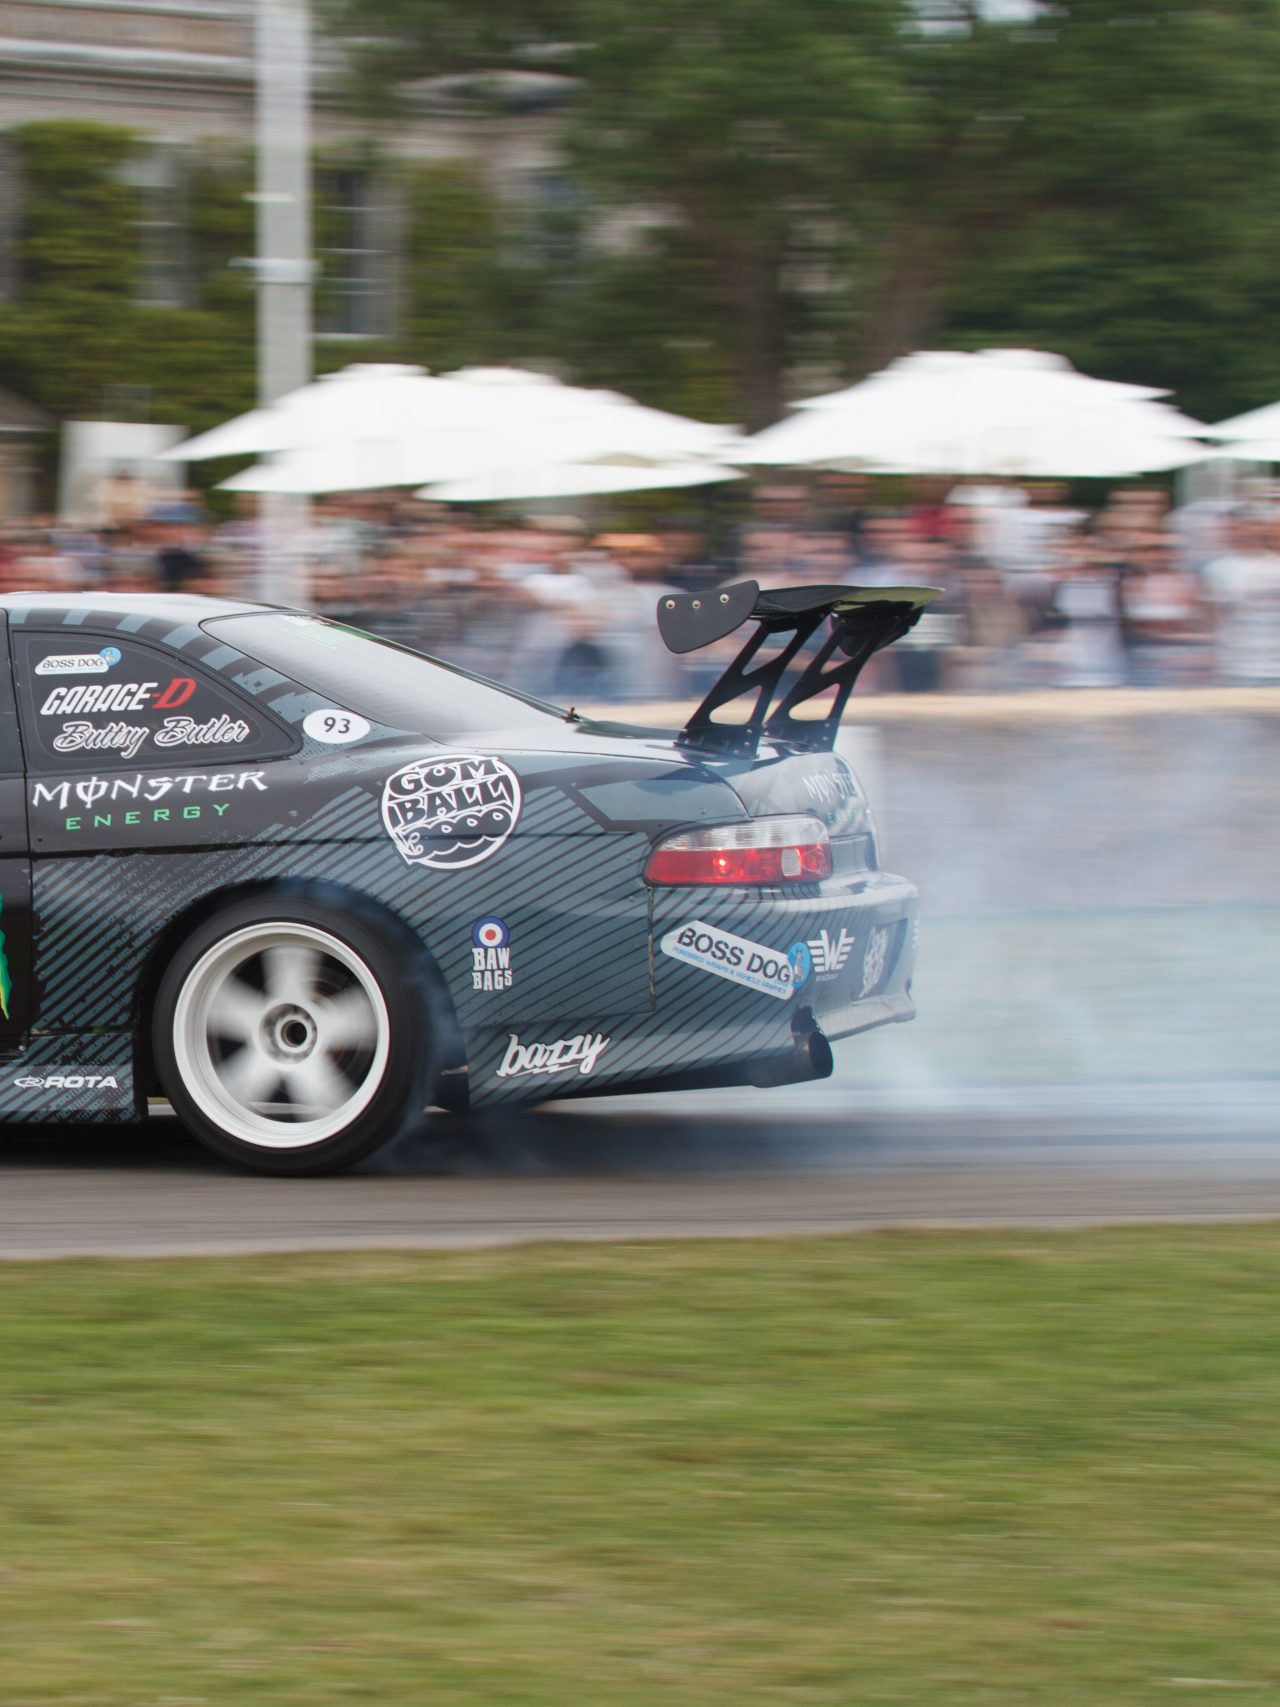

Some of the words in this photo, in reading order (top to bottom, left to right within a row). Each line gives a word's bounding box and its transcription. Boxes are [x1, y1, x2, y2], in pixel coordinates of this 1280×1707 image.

[42, 659, 74, 669] BOSS
[77, 658, 104, 668] DOG
[40, 677, 197, 716] GARAGE-D
[154, 713, 250, 747] Butler
[323, 716, 351, 734] 93
[32, 770, 269, 810] MONSTER
[65, 803, 230, 831] ENERGY
[472, 947, 510, 971] BAW
[676, 927, 744, 967] BOSS
[746, 952, 791, 983] DOG
[472, 969, 512, 990] BAGS
[44, 1076, 118, 1088] ROTA
